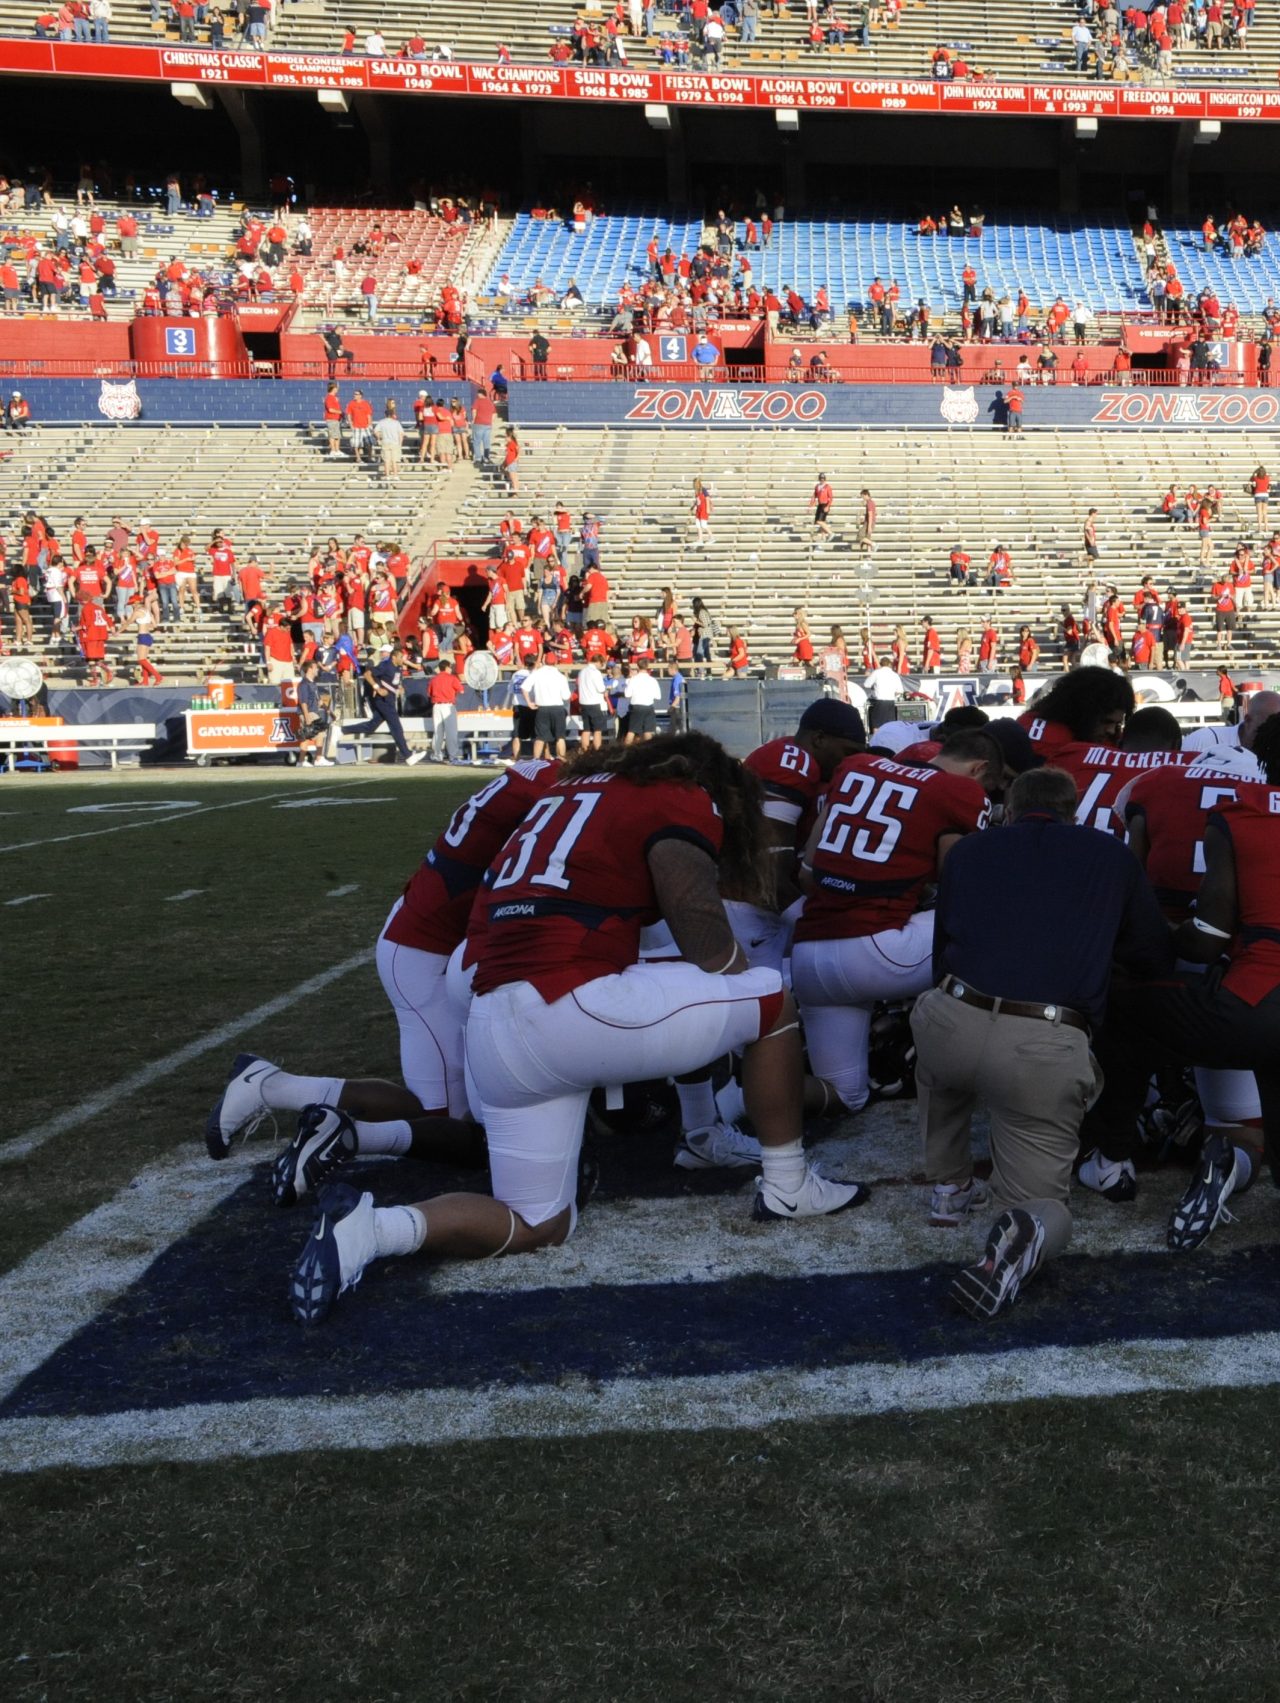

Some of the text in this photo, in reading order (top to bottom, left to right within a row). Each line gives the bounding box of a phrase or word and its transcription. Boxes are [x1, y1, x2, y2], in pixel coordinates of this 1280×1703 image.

[163, 51, 262, 69] CHRISTMAS CLASSIC
[268, 55, 364, 67] BORDER CONFERENCE
[200, 69, 228, 79] 1921
[289, 64, 344, 74] CHAMPIONS
[371, 62, 463, 78] SALAD BOWL
[471, 66, 560, 83] WAC CHAMPIONS
[272, 74, 363, 86] 1935, 1936 & 1985
[404, 79, 432, 89] 1949
[574, 71, 653, 87] SUN BOWL
[665, 76, 751, 91] FIESTA BOWL
[481, 82, 552, 94] 1964 & 1973
[579, 86, 648, 99] 1968 & 1985
[760, 80, 844, 94] ALOHA BOWL
[853, 82, 936, 96] COPPER BOWL
[943, 85, 1025, 100] JOHN HANCOCK BOWL
[675, 90, 743, 103] 1979 & 1994
[769, 94, 836, 105] 1986 & 1990
[1033, 88, 1115, 101] PAC 10 CHAMPIONS
[1123, 92, 1202, 104] FREEDOM BOWL
[1209, 93, 1262, 105] INSIGHT.COM
[881, 98, 906, 108] 1989
[972, 100, 997, 110] 1992
[1062, 102, 1087, 112] 1993
[1150, 105, 1175, 115] 1994
[1237, 107, 1261, 117] 1997
[173, 330, 188, 346] 3
[667, 338, 680, 353] 4
[198, 725, 264, 737] GATORADE
[1028, 718, 1046, 740] 8
[780, 745, 810, 777] 21
[1083, 747, 1191, 768] MITCHELL
[817, 771, 918, 863] 25
[821, 876, 856, 892] ARIZONA
[494, 903, 535, 918] ARIZONA
